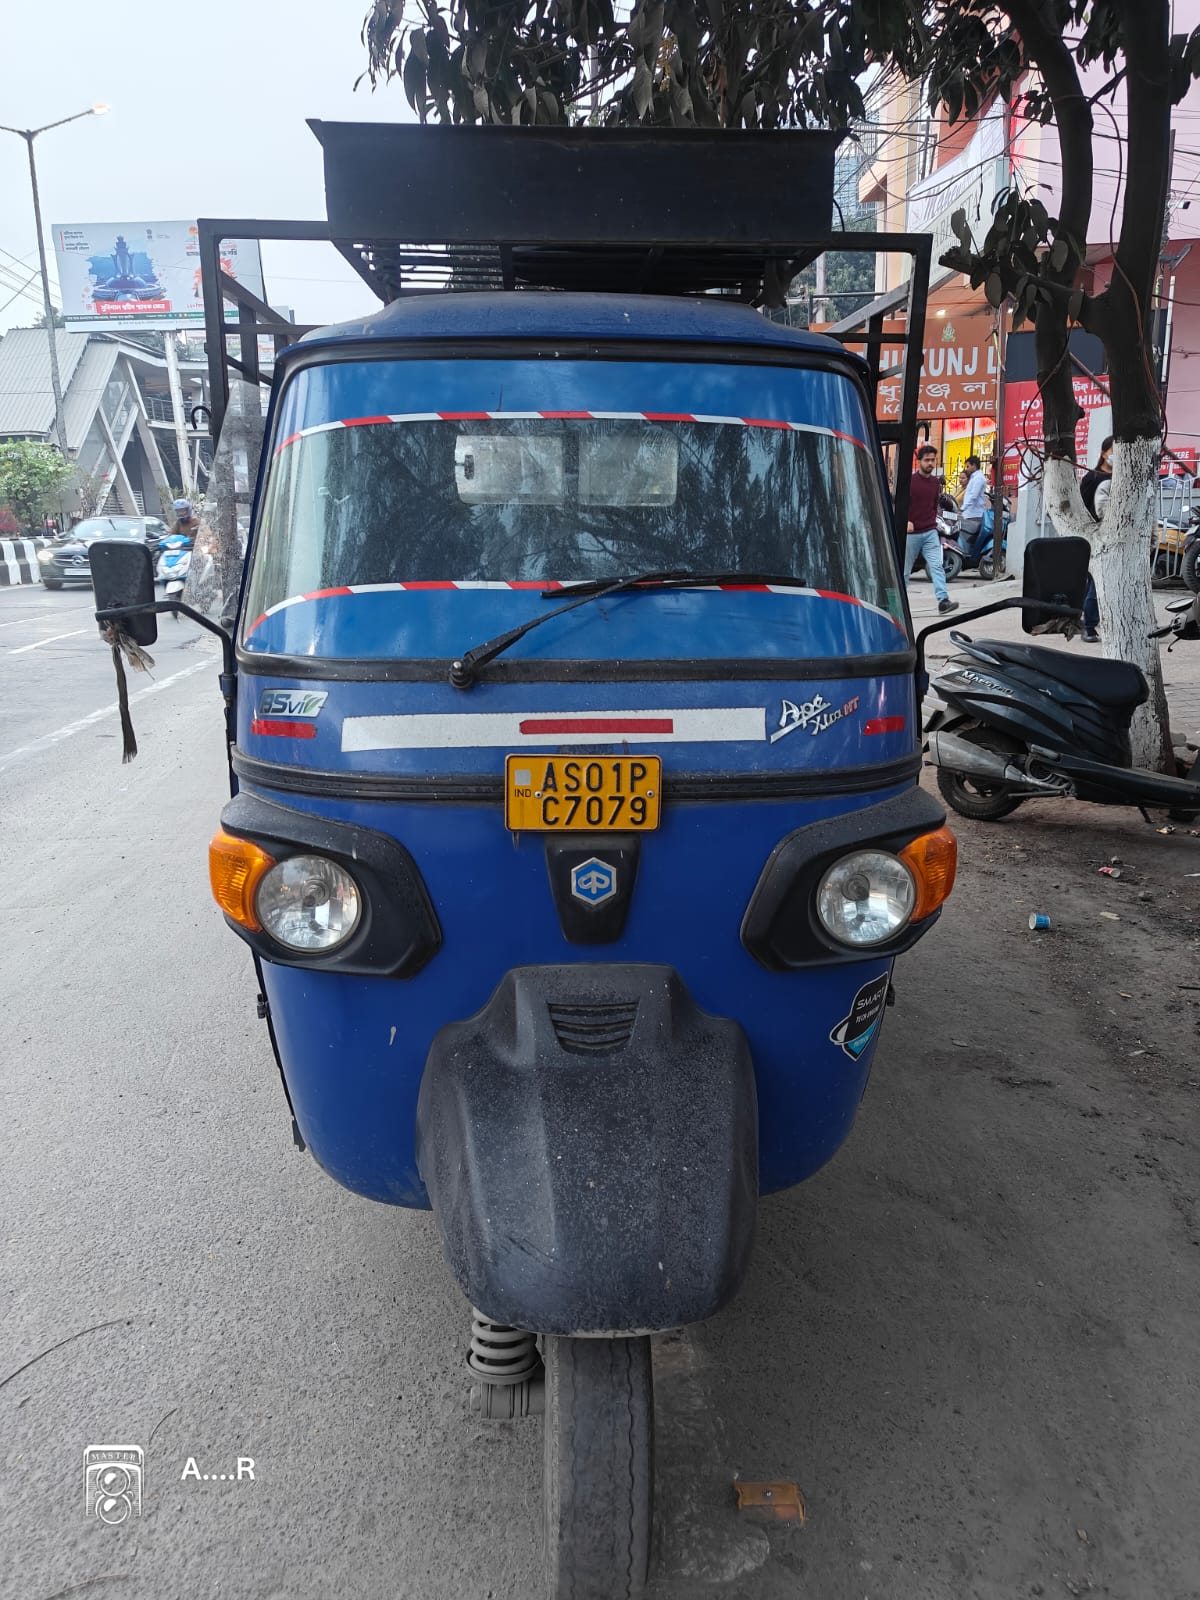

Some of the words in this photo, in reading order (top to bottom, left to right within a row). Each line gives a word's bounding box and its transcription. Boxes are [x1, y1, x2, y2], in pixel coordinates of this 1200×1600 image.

[883, 402, 947, 415] KAALA
[950, 399, 998, 412] TOWE
[542, 762, 648, 793] AS01P
[514, 789, 532, 798] IND
[542, 795, 648, 826] C7079
